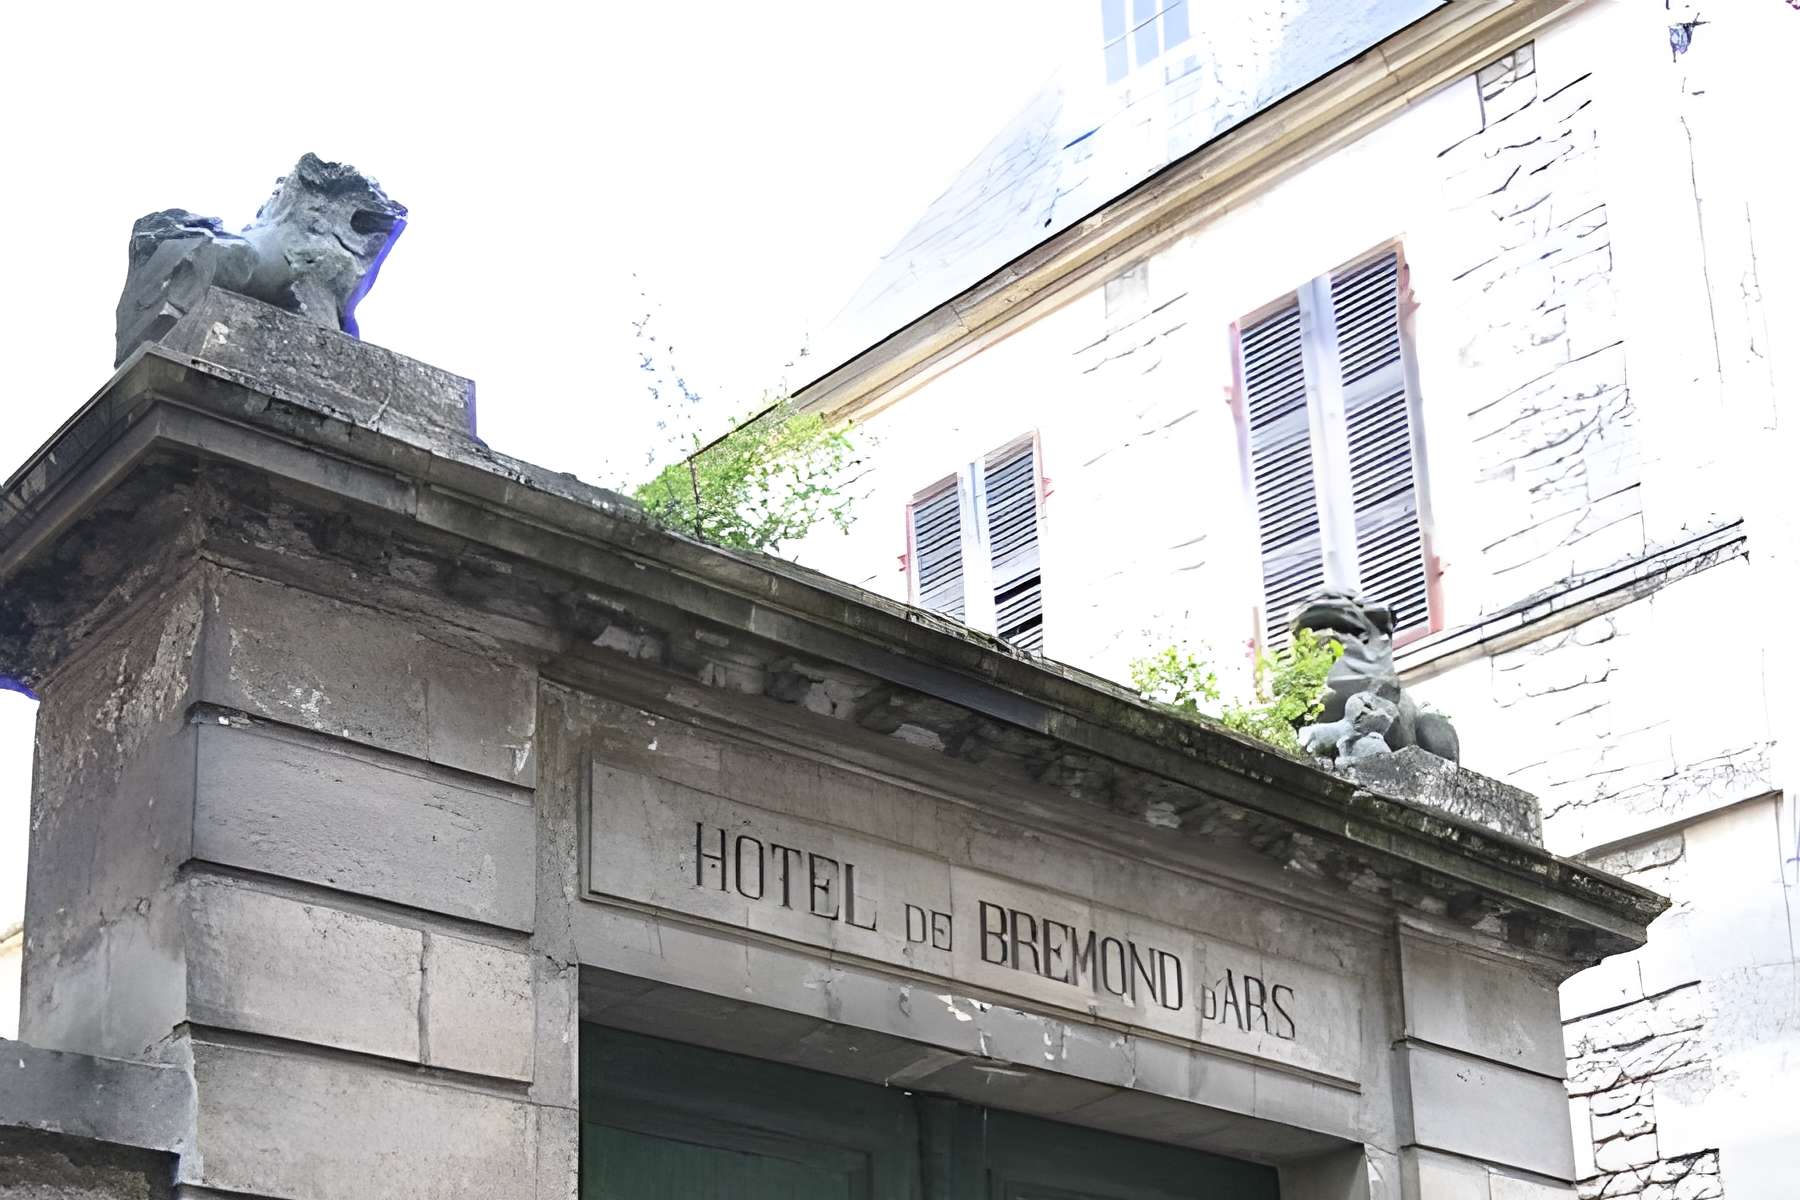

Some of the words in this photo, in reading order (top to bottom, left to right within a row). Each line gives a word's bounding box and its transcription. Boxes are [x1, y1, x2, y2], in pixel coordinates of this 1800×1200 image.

[694, 821, 877, 932] HOTEL
[905, 903, 952, 952] DE
[978, 900, 1183, 1010] BREMOND
